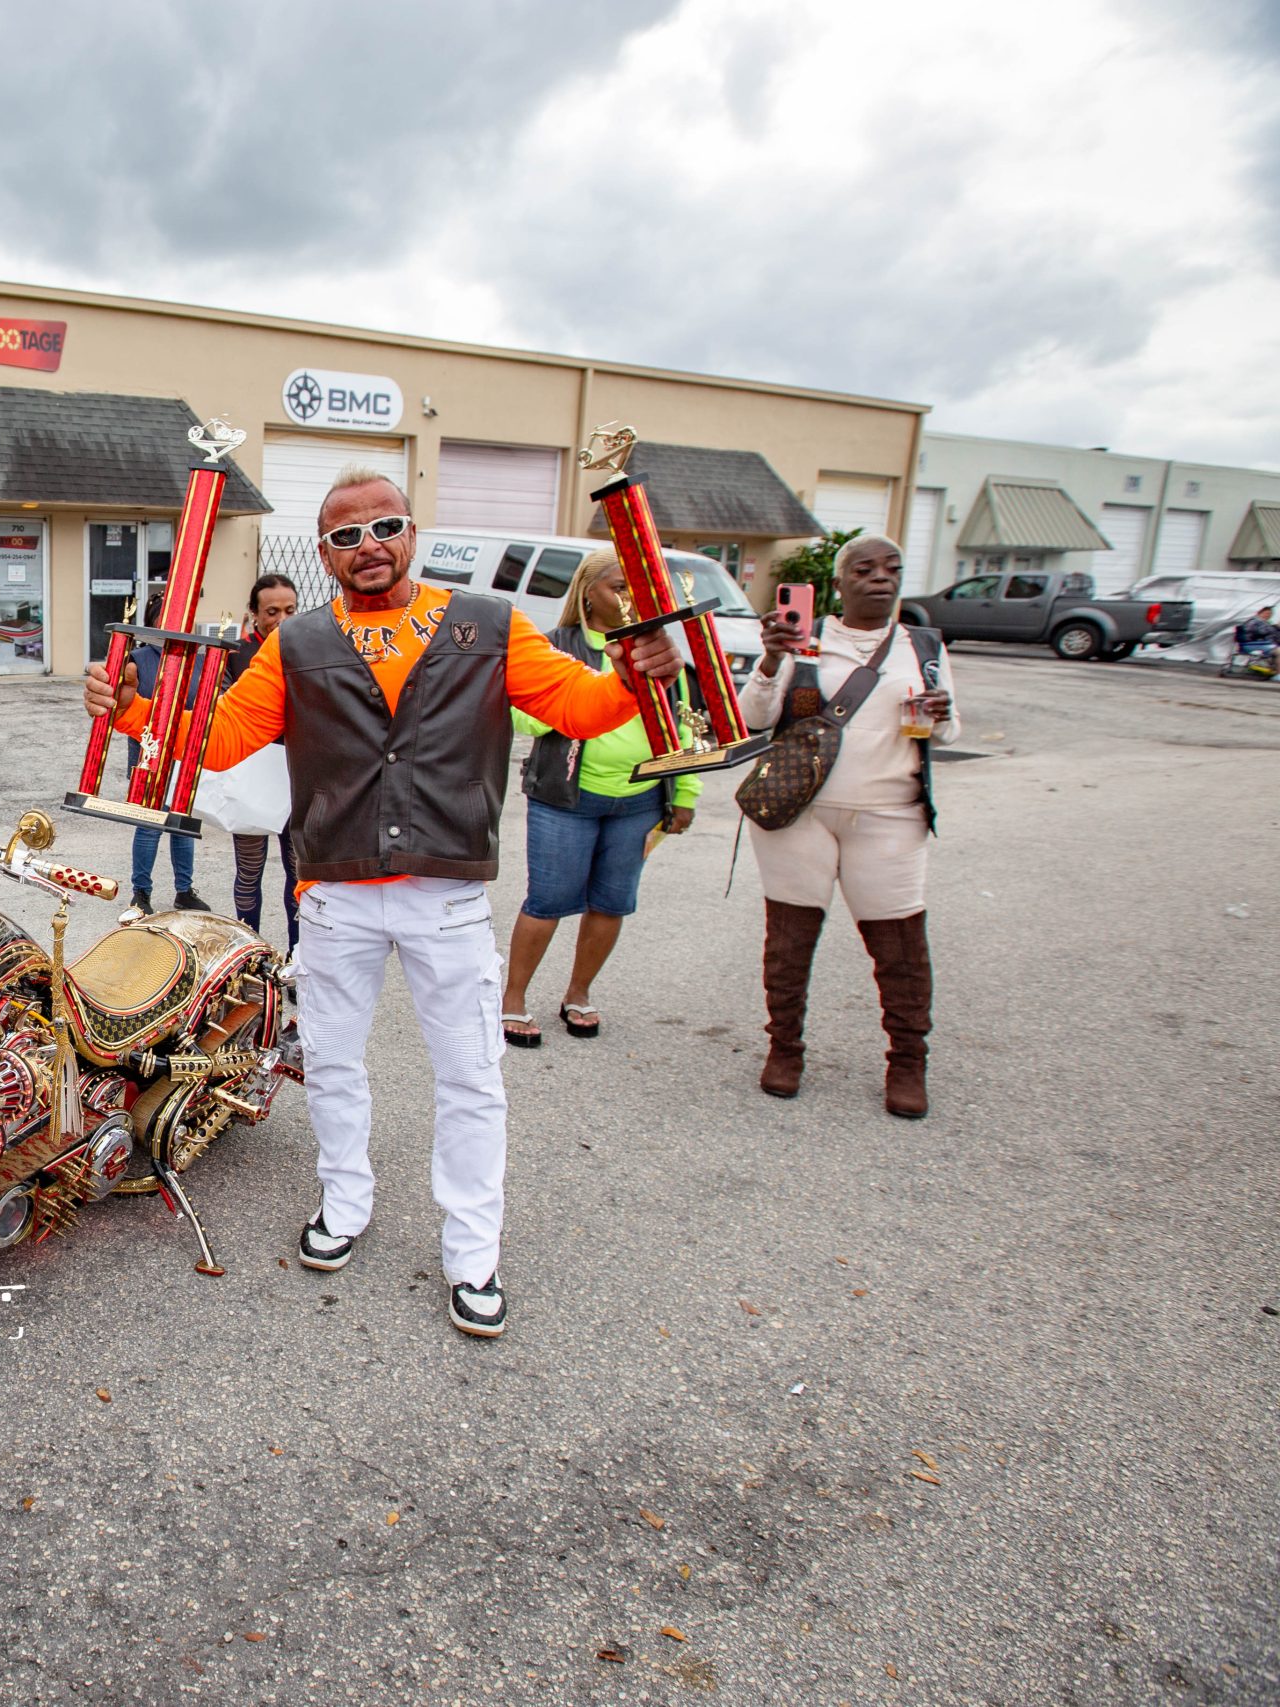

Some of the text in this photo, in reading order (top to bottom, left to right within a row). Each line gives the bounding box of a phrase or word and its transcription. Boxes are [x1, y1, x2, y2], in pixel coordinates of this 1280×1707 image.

[328, 388, 391, 415] BMC
[12, 524, 25, 532] 710
[431, 542, 480, 562] BMC
